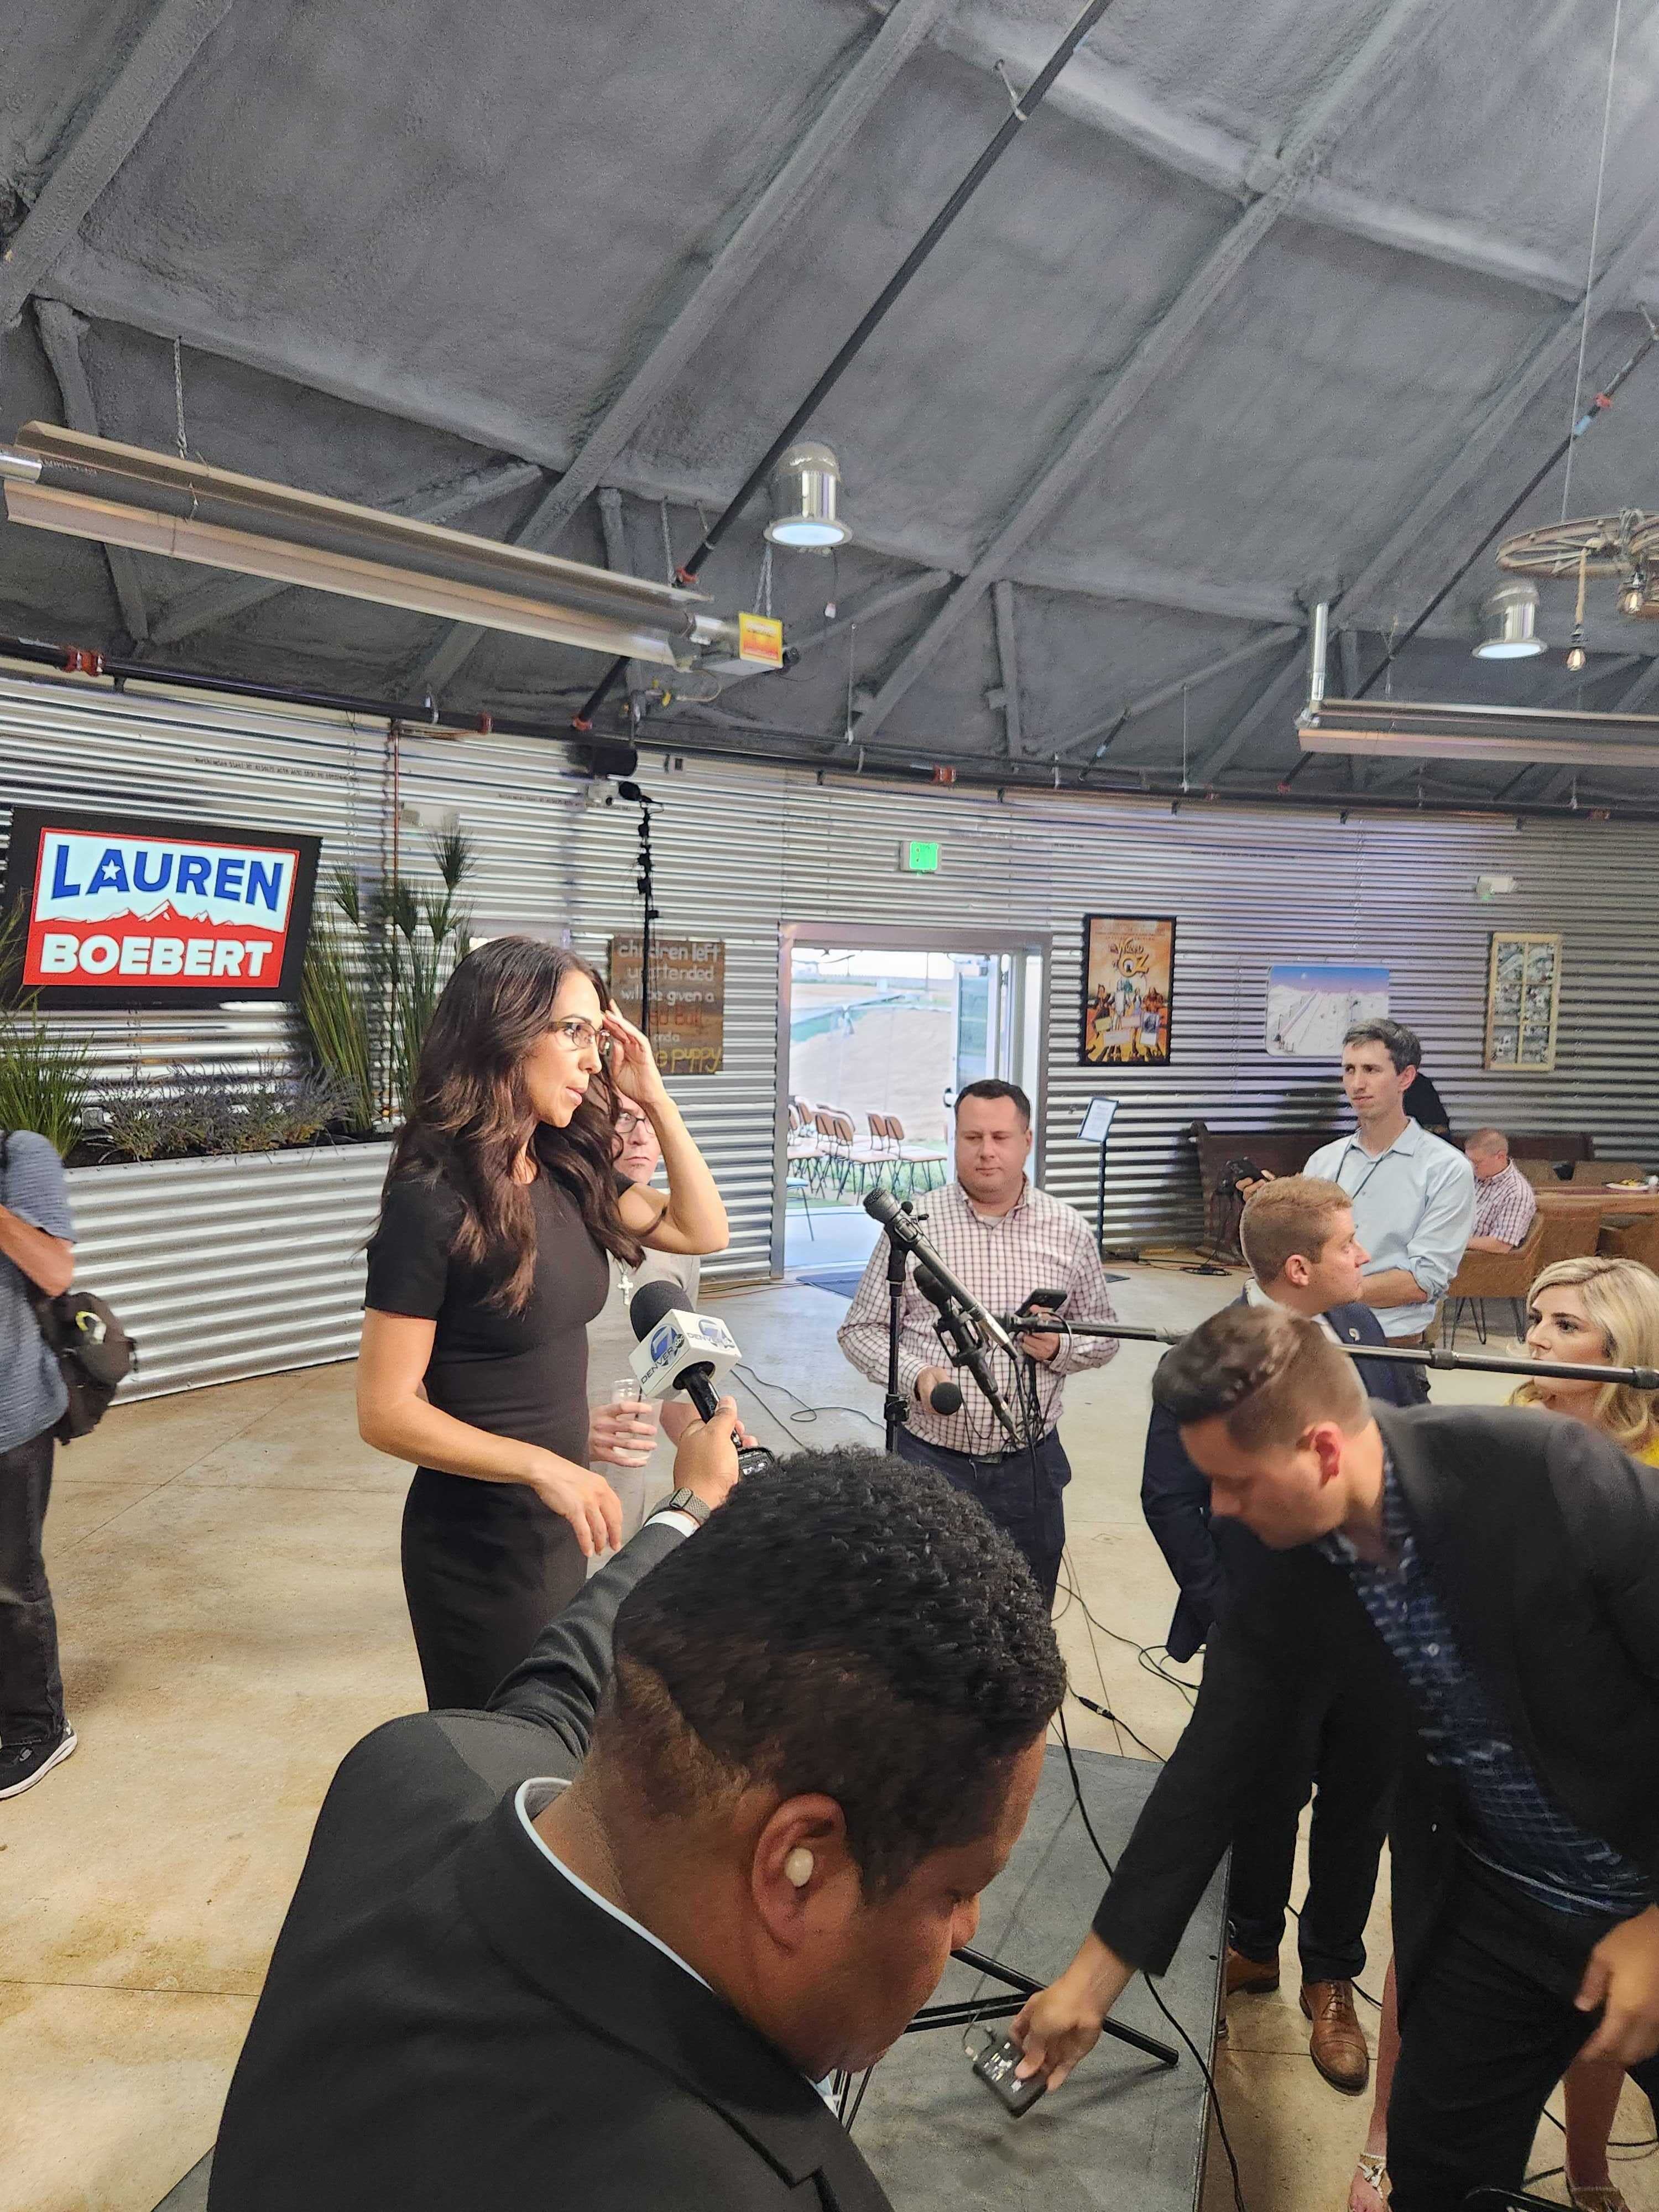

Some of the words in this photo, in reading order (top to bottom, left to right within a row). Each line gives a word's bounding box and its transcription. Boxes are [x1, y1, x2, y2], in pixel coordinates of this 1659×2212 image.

[51, 844, 283, 912] LAUREN
[40, 933, 273, 977] BOEBERT
[619, 940, 688, 961] chidren
[671, 1046, 722, 1073] puppy
[641, 1347, 673, 1384] DENVER
